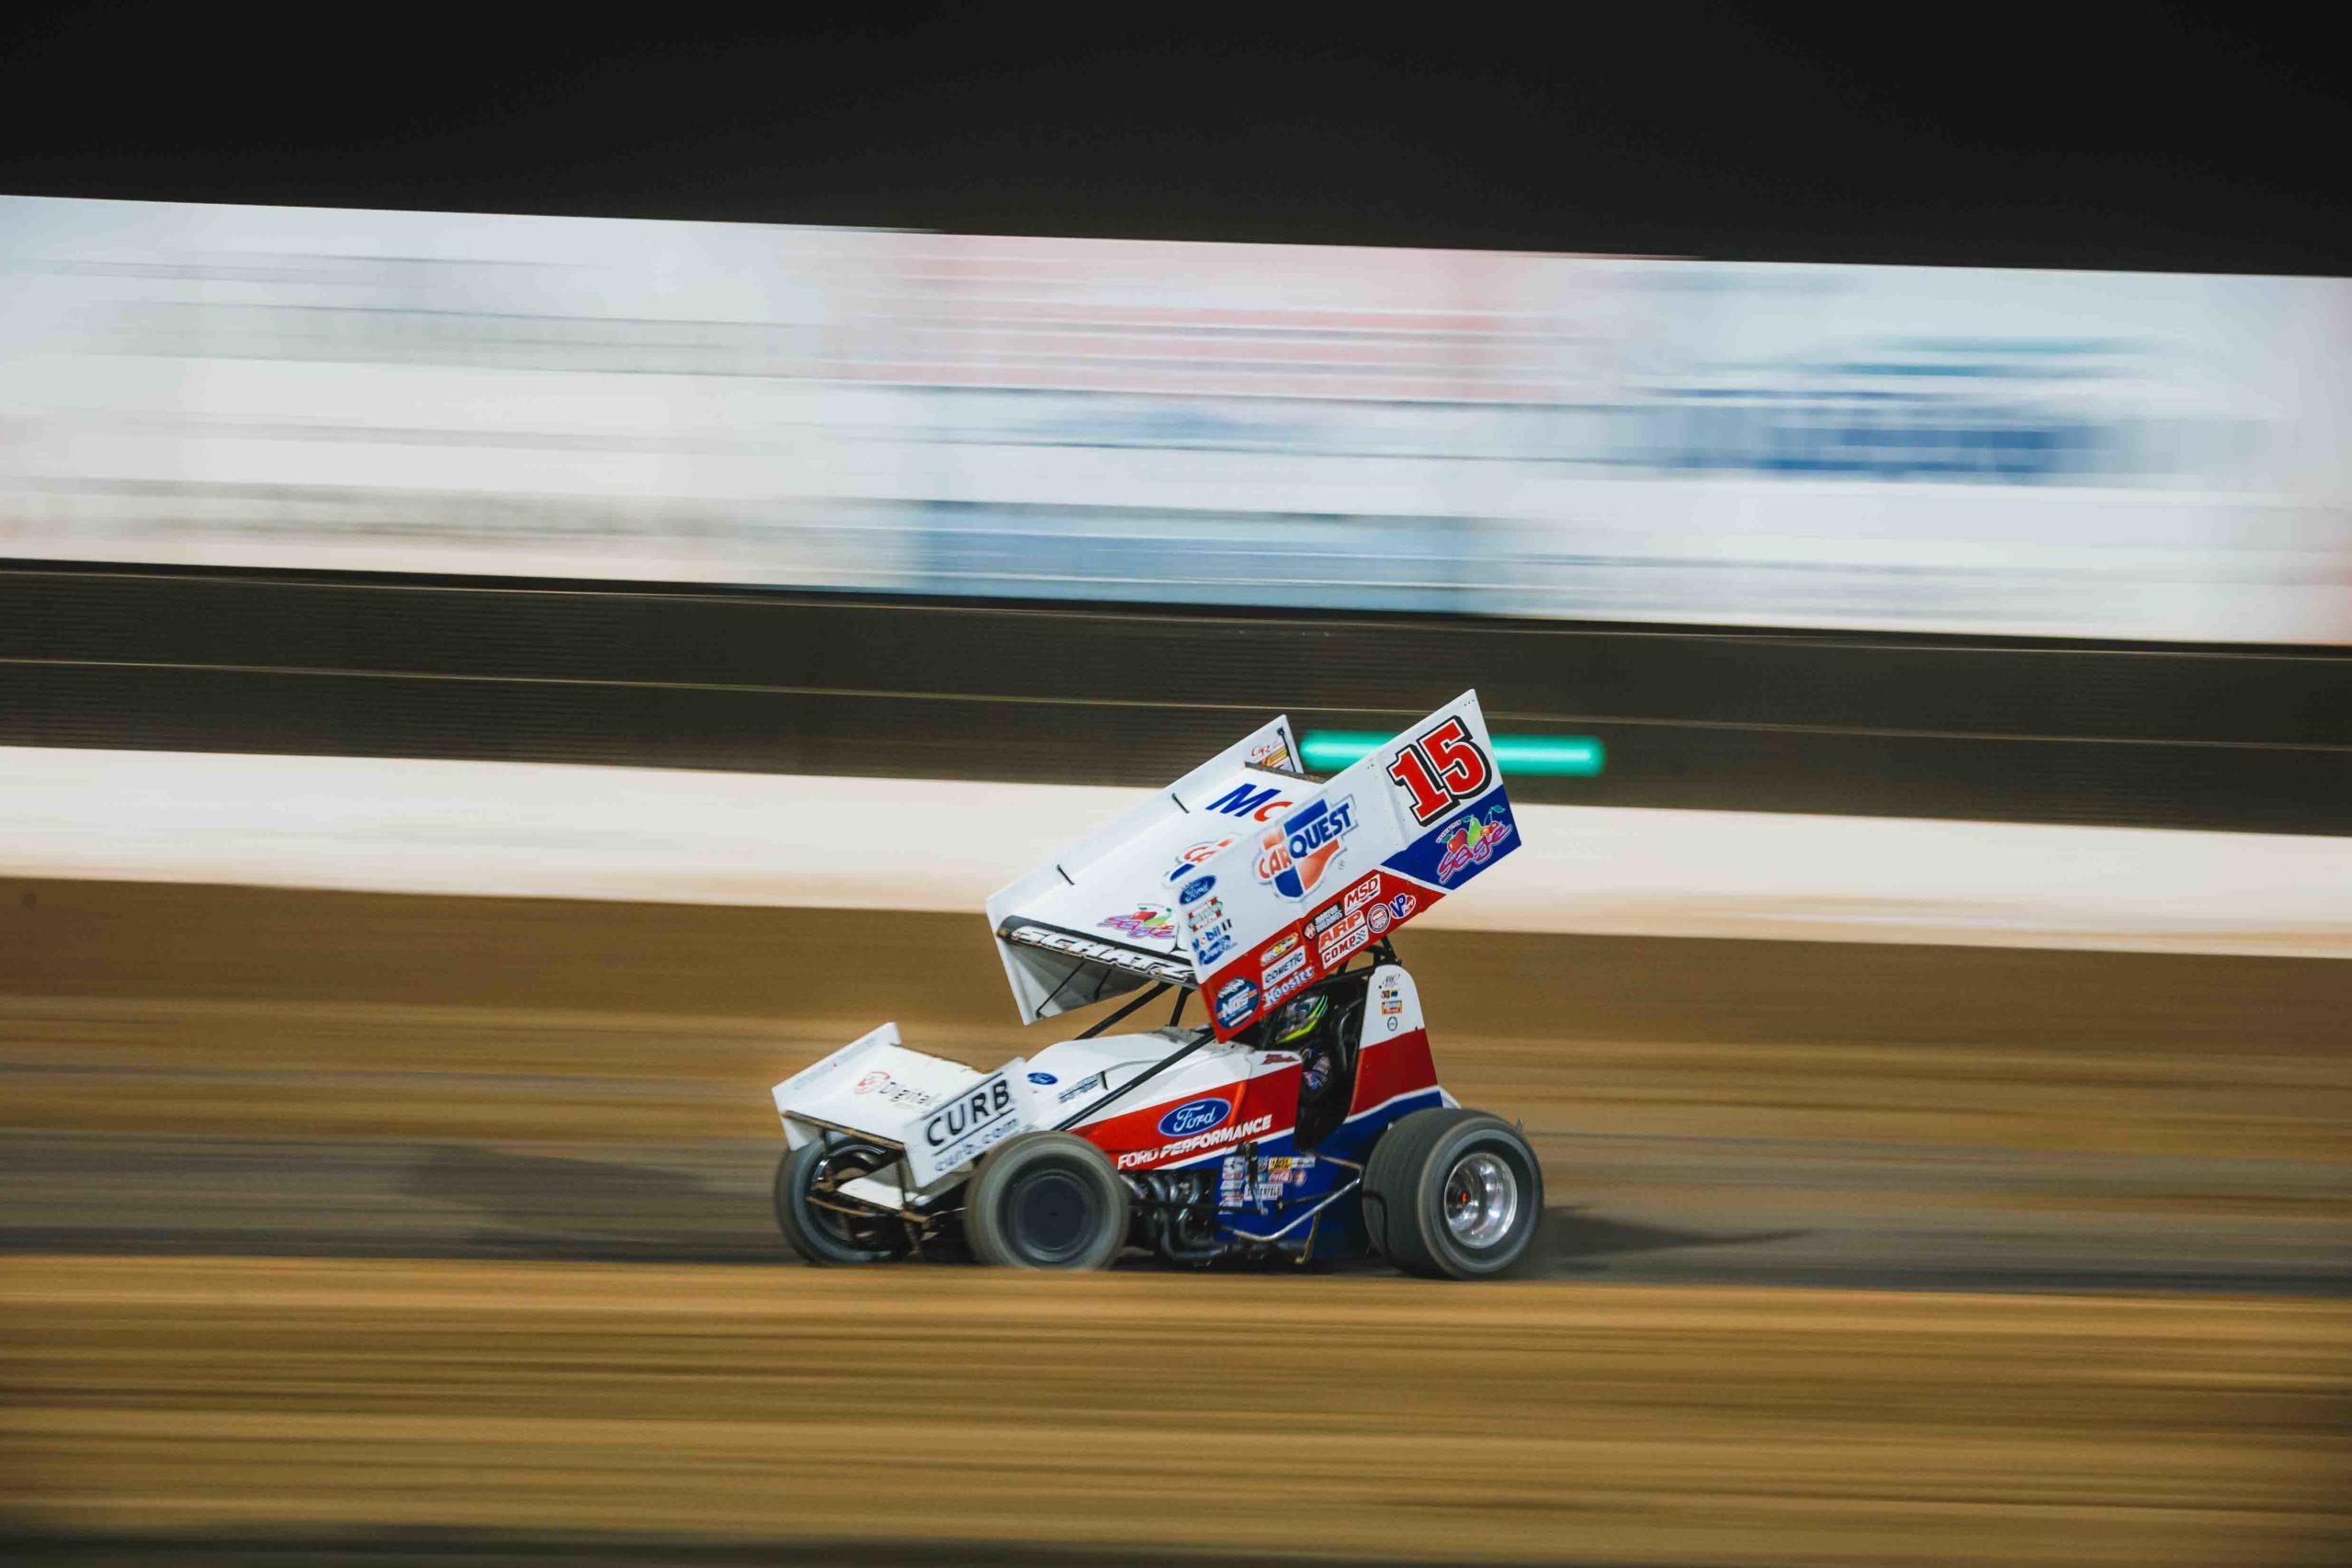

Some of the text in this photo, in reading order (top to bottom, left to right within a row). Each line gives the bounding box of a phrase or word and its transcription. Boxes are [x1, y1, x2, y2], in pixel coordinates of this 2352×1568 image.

[1386, 716, 1492, 827] 15
[1184, 884, 1209, 903] Ford
[1346, 878, 1379, 908] MSD
[1389, 894, 1408, 918] VP
[1320, 911, 1363, 949] ARP
[1324, 936, 1357, 963] COMP
[1265, 953, 1304, 983] COMETIC
[1262, 965, 1315, 1010] Hoosier
[927, 1078, 1010, 1147] CURB
[1175, 1104, 1216, 1133] Ford
[935, 1118, 1020, 1172] curb.com
[1117, 1114, 1273, 1171] FORD PERFORMANCE
